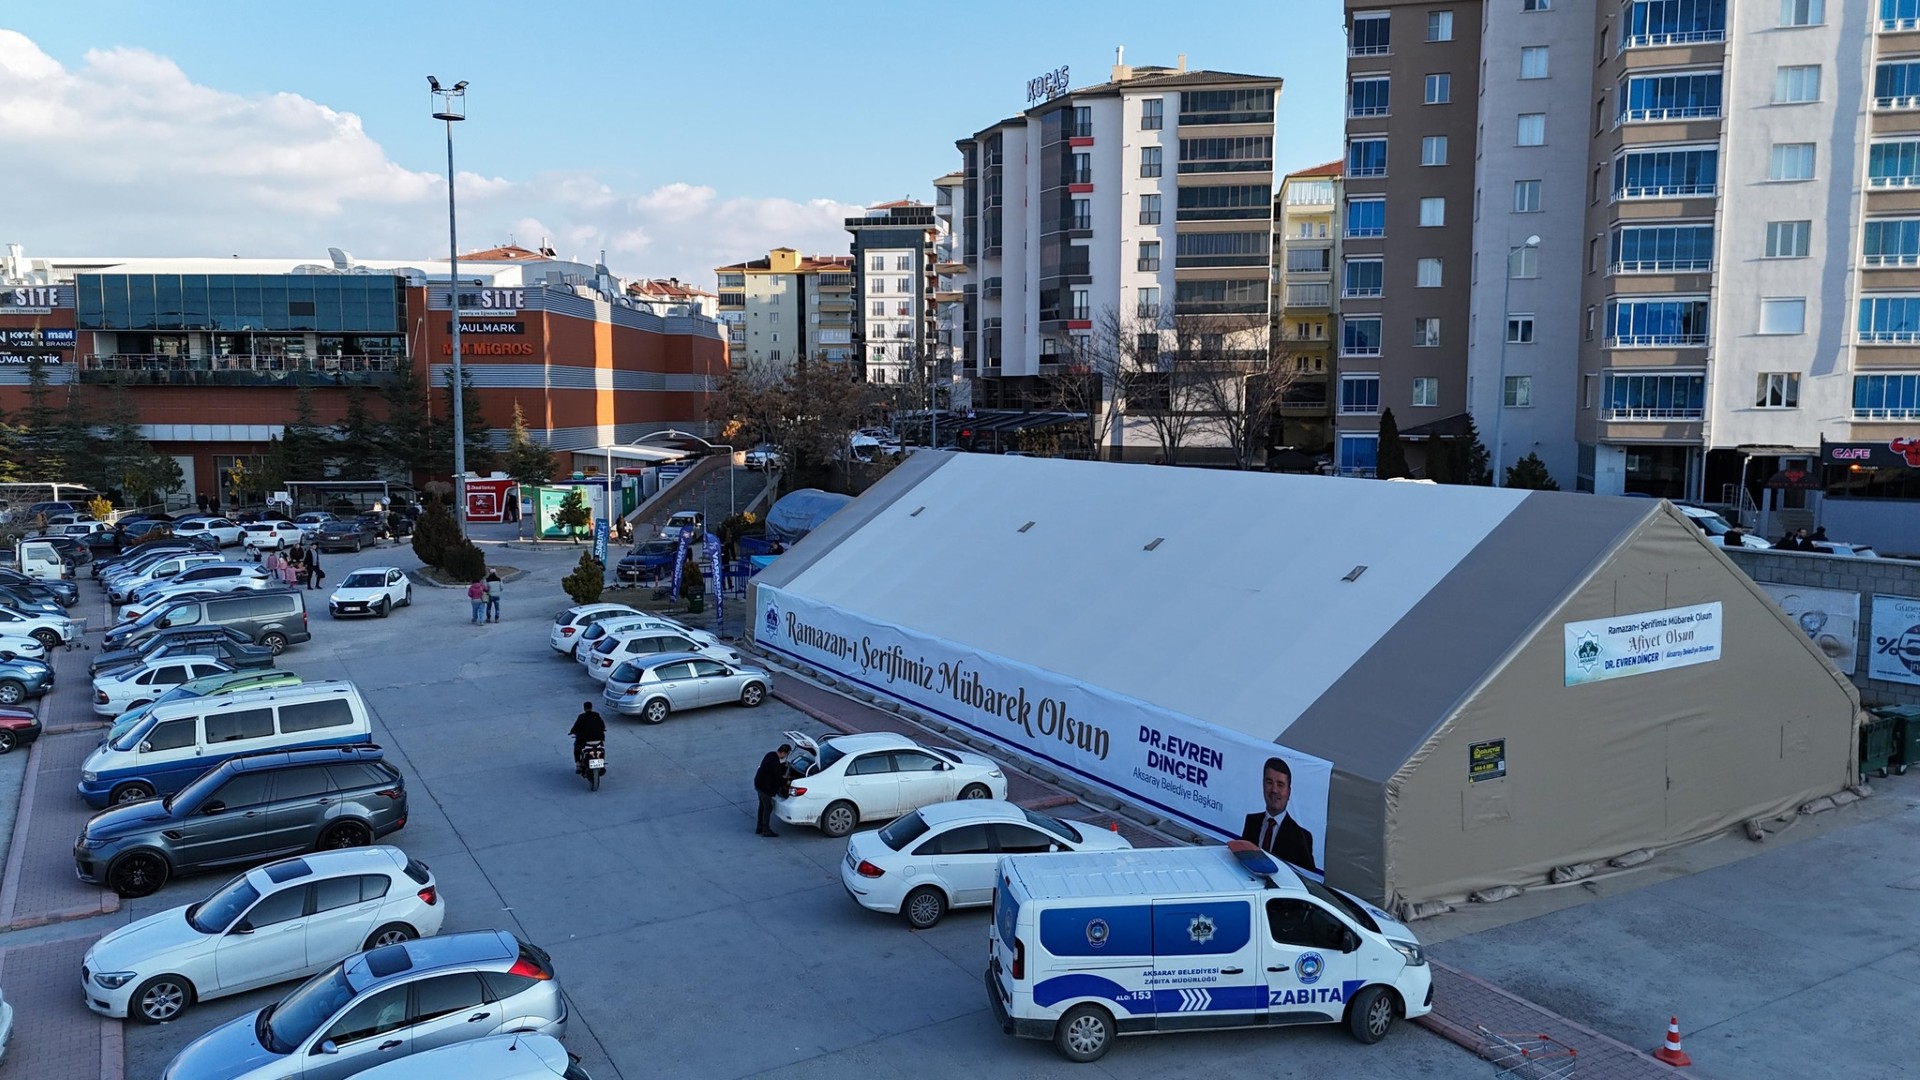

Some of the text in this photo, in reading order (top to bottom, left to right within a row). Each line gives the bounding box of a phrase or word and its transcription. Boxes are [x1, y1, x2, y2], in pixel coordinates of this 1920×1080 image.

[47, 330, 73, 339] mavi
[27, 353, 60, 364] OTİK
[1832, 448, 1871, 459] CAFE
[1640, 618, 1668, 632] Şerifimiz
[1668, 613, 1694, 625] Mübarek
[1696, 611, 1713, 621] Olsun
[1627, 628, 1694, 654] Afiyet Olsun
[1605, 659, 1615, 670] DR.
[1616, 656, 1637, 668] EVREN
[785, 611, 1110, 761] Ramazan-ı Şerifimiz Mübarek Olsun
[1132, 767, 1223, 813] Aksaray Belediye Başkanı
[1142, 967, 1219, 977] AKSARAY BELEDİYESİ
[1144, 976, 1217, 985] ZABITA MÜDÜRLÜĞÜ
[1131, 991, 1151, 1000] 153
[1269, 987, 1342, 1006] ZABITA
